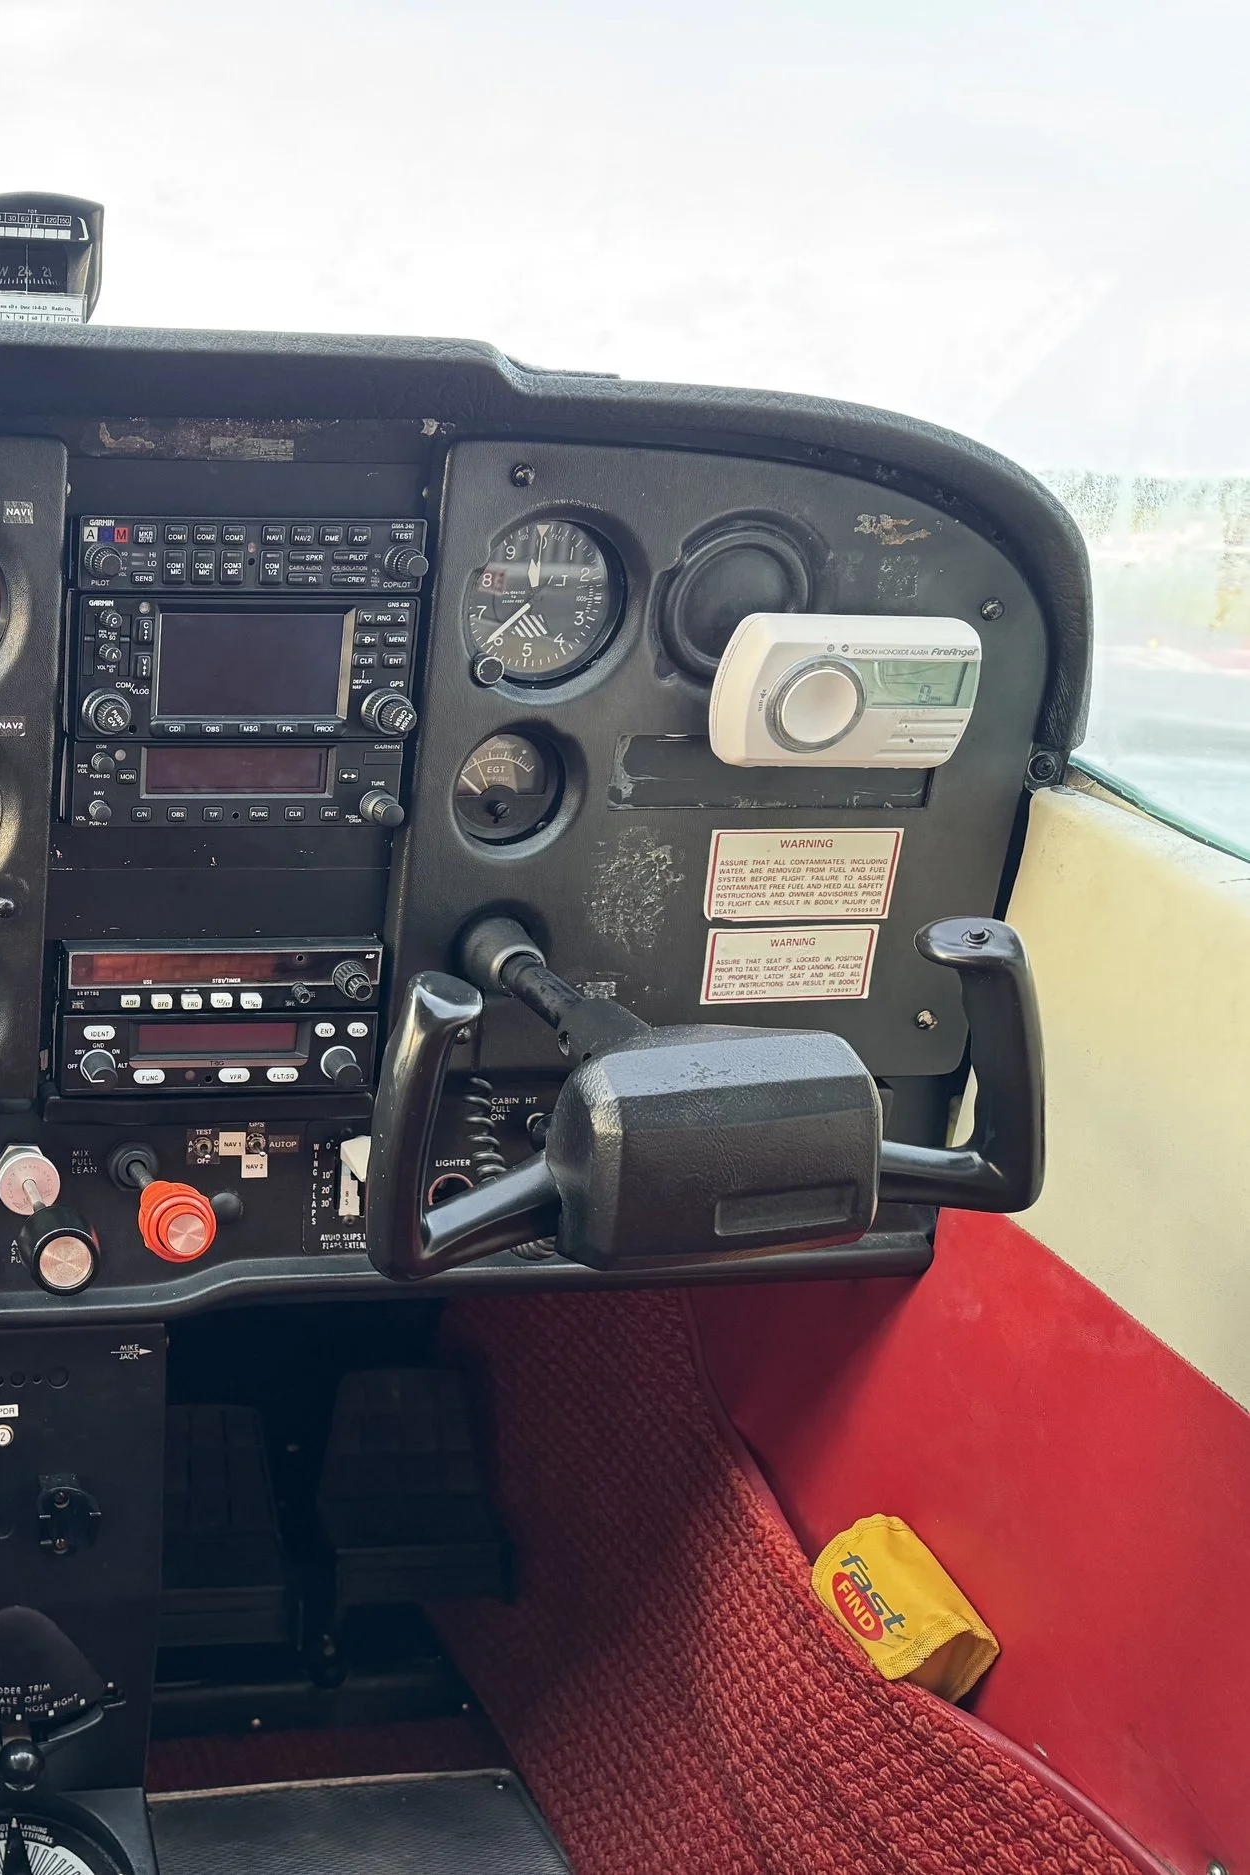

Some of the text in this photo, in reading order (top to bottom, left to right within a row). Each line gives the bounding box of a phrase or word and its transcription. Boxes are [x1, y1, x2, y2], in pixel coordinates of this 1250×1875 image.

[6, 508, 31, 516] NAV1
[780, 839, 833, 848] WARNING
[770, 938, 816, 947] WARNING
[836, 1581, 876, 1631] FIND
[28, 1684, 50, 1693] TRIM
